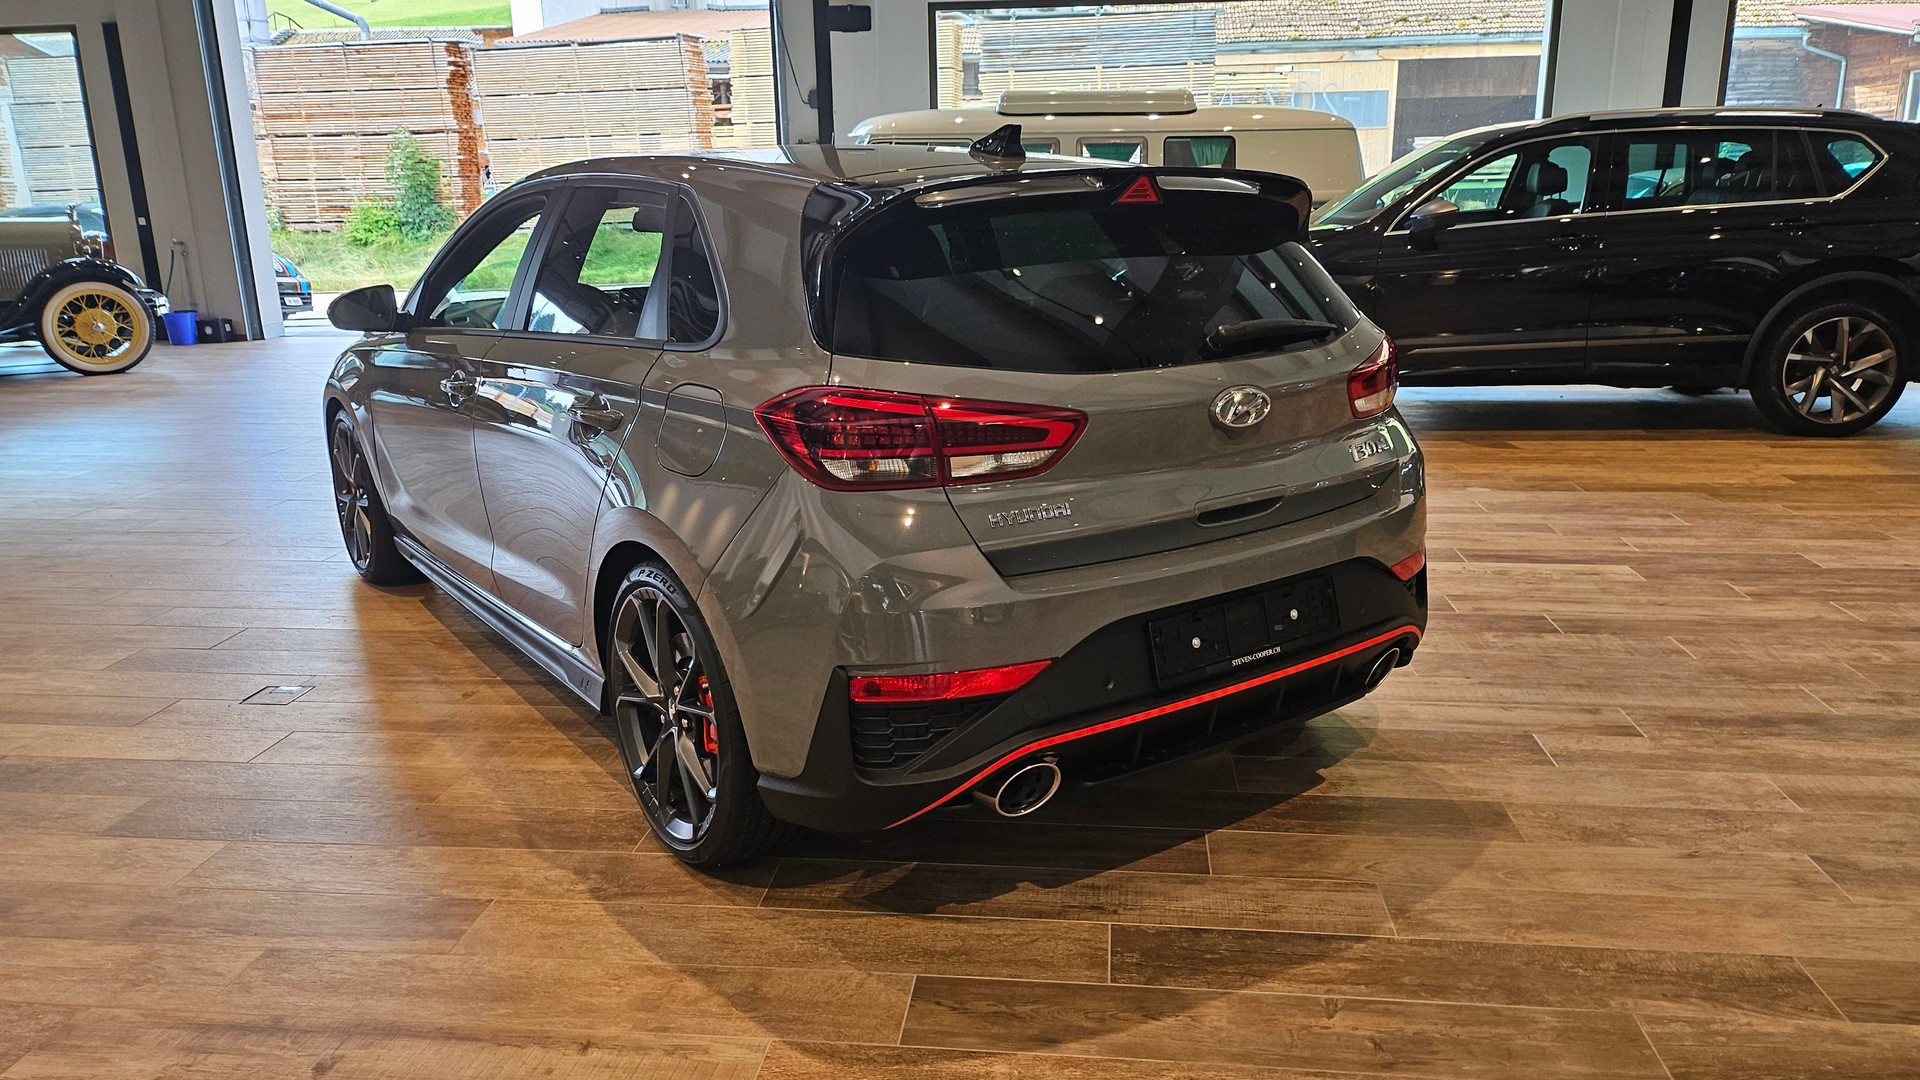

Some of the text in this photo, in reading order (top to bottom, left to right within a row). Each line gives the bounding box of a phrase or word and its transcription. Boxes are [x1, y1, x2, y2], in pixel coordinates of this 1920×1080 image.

[988, 502, 1072, 528] HYUNDAI
[637, 569, 677, 595] P ZERO
[1231, 646, 1281, 667] STEVEN-COOPER.CH
